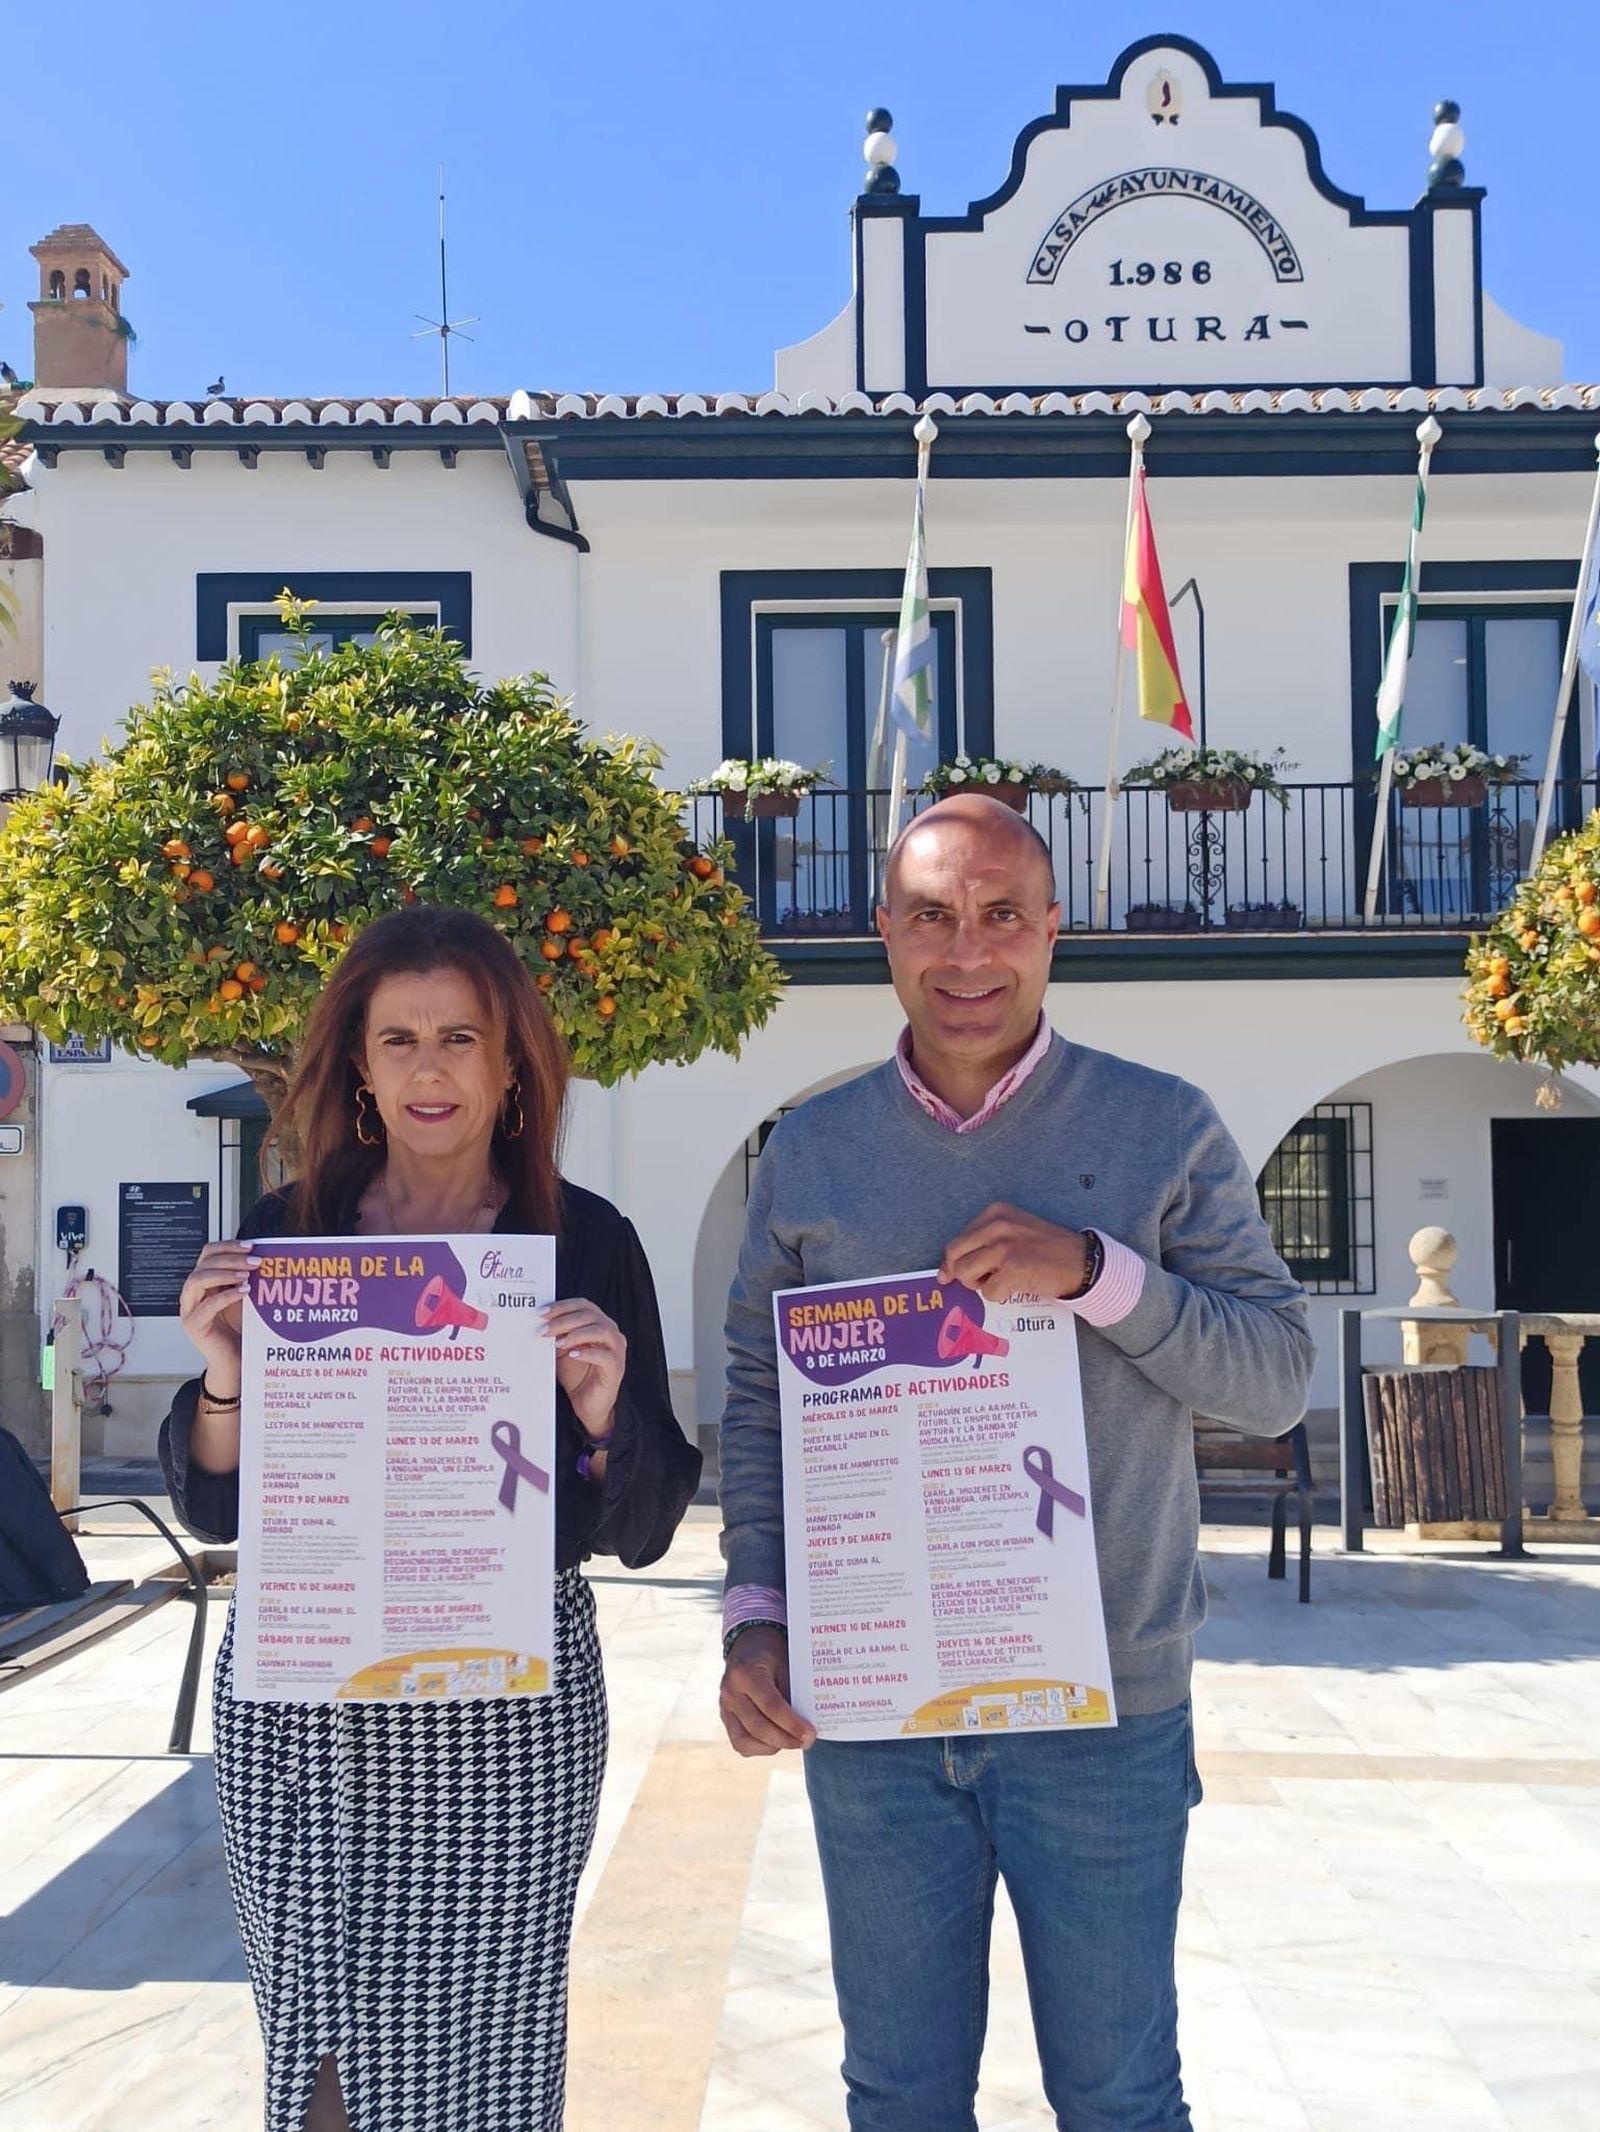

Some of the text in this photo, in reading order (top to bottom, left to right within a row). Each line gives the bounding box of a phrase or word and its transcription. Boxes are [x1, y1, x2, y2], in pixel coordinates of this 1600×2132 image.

[1036, 211, 1087, 277] CASA
[1119, 171, 1296, 274] AYUNTAMIENTO
[1109, 259, 1212, 286] 1.986
[259, 1255, 423, 1278] SEMANA DE LA
[257, 1277, 359, 1306] MUJER
[499, 1293, 536, 1308] Otura
[273, 1308, 357, 1322] 8 DE MARZO
[788, 1288, 943, 1327] SEMANA DE LA
[1016, 1314, 1055, 1333] Otura
[789, 1316, 886, 1355] MUJER
[266, 1345, 485, 1362] PROGRAMA DE ACTIVIDADES
[805, 1347, 886, 1369] 8 DE MARZO
[336, 1368, 367, 1376] MARZO
[802, 1371, 1010, 1407] PROGRAMA DE ACTIVIDADES
[868, 1404, 898, 1416] MARZO
[978, 1462, 1012, 1473] MARZO
